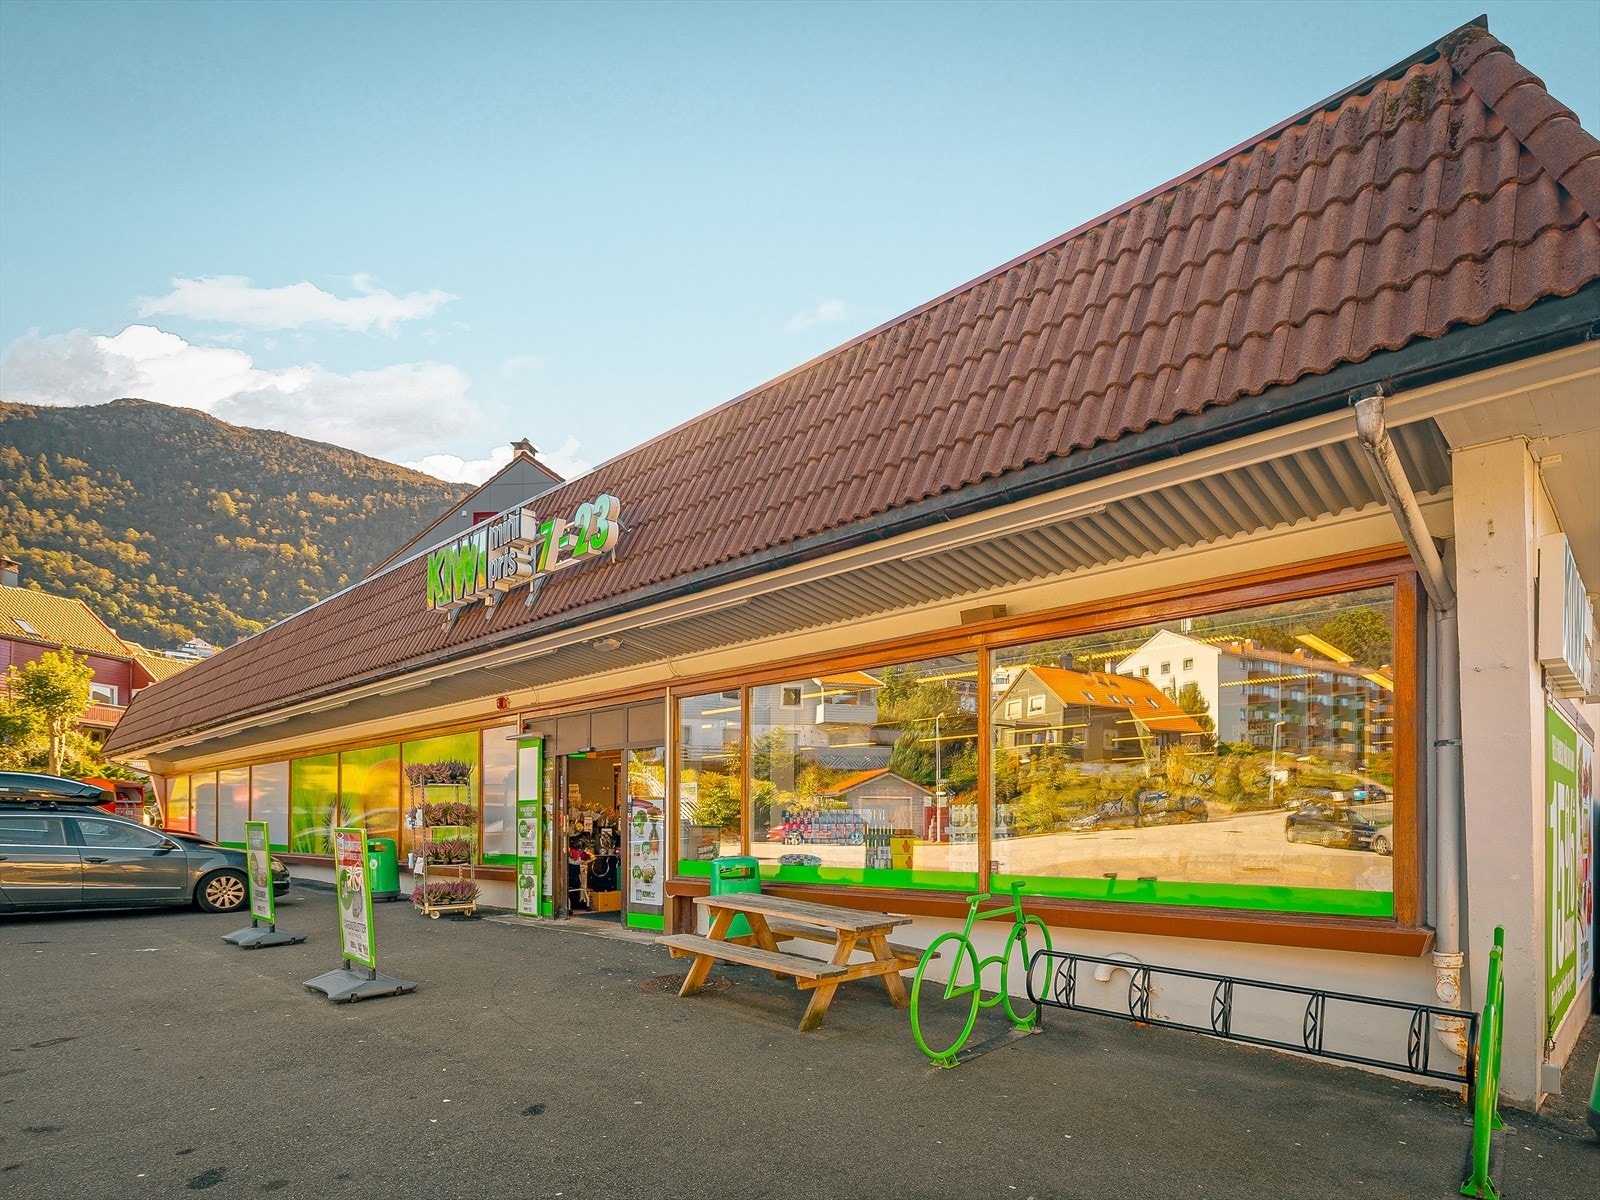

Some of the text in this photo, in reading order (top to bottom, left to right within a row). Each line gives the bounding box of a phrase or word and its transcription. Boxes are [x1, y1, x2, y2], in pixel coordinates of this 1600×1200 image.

[489, 507, 521, 551] mini
[537, 494, 611, 573] 7-23
[427, 525, 489, 612] KIWI
[489, 546, 518, 589] pris
